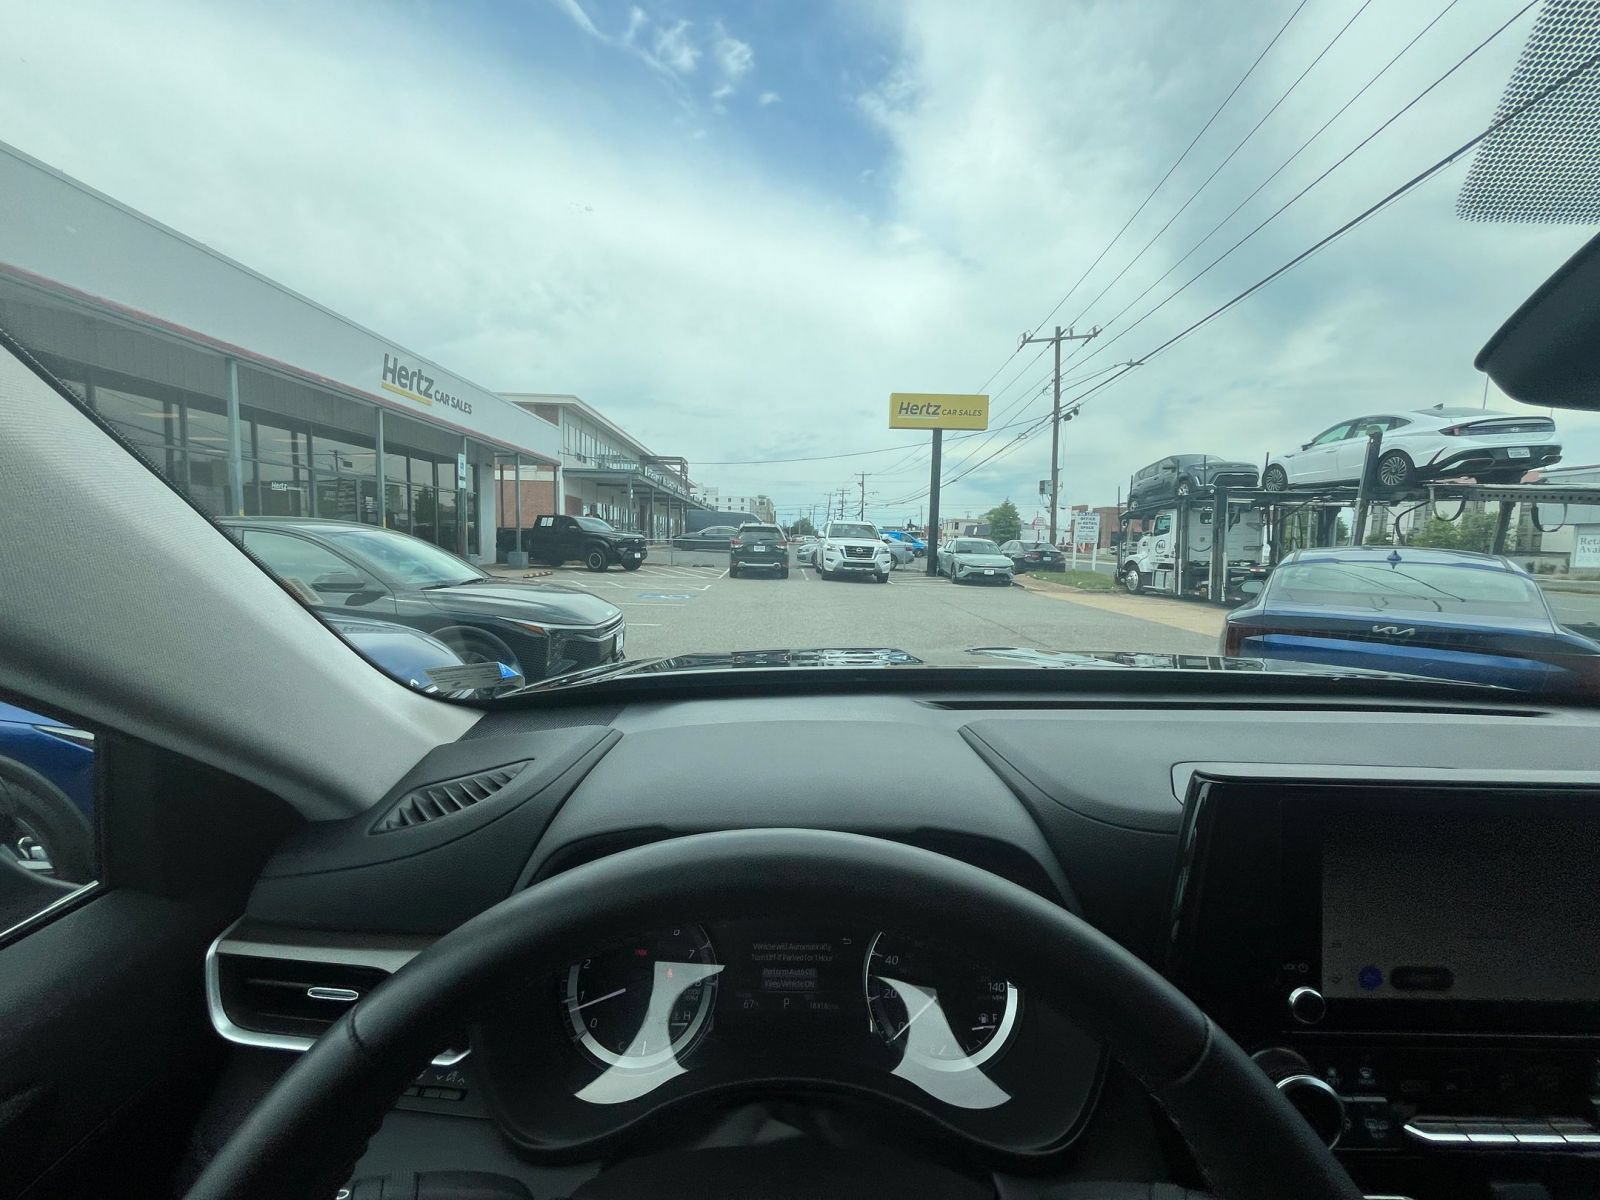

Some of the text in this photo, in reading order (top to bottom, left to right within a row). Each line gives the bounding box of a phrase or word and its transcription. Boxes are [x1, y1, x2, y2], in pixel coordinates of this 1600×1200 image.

[382, 353, 473, 415] Hertz CAR SALES
[898, 401, 982, 417] Hertz CAR SALES
[688, 949, 696, 959] 7
[583, 959, 592, 969] 2
[885, 955, 899, 966] 40
[987, 982, 1005, 993] 140
[884, 988, 898, 999] 20
[783, 997, 790, 1009] P
[683, 1011, 691, 1020] H
[992, 1013, 998, 1023] F
[590, 1017, 598, 1028] 0
